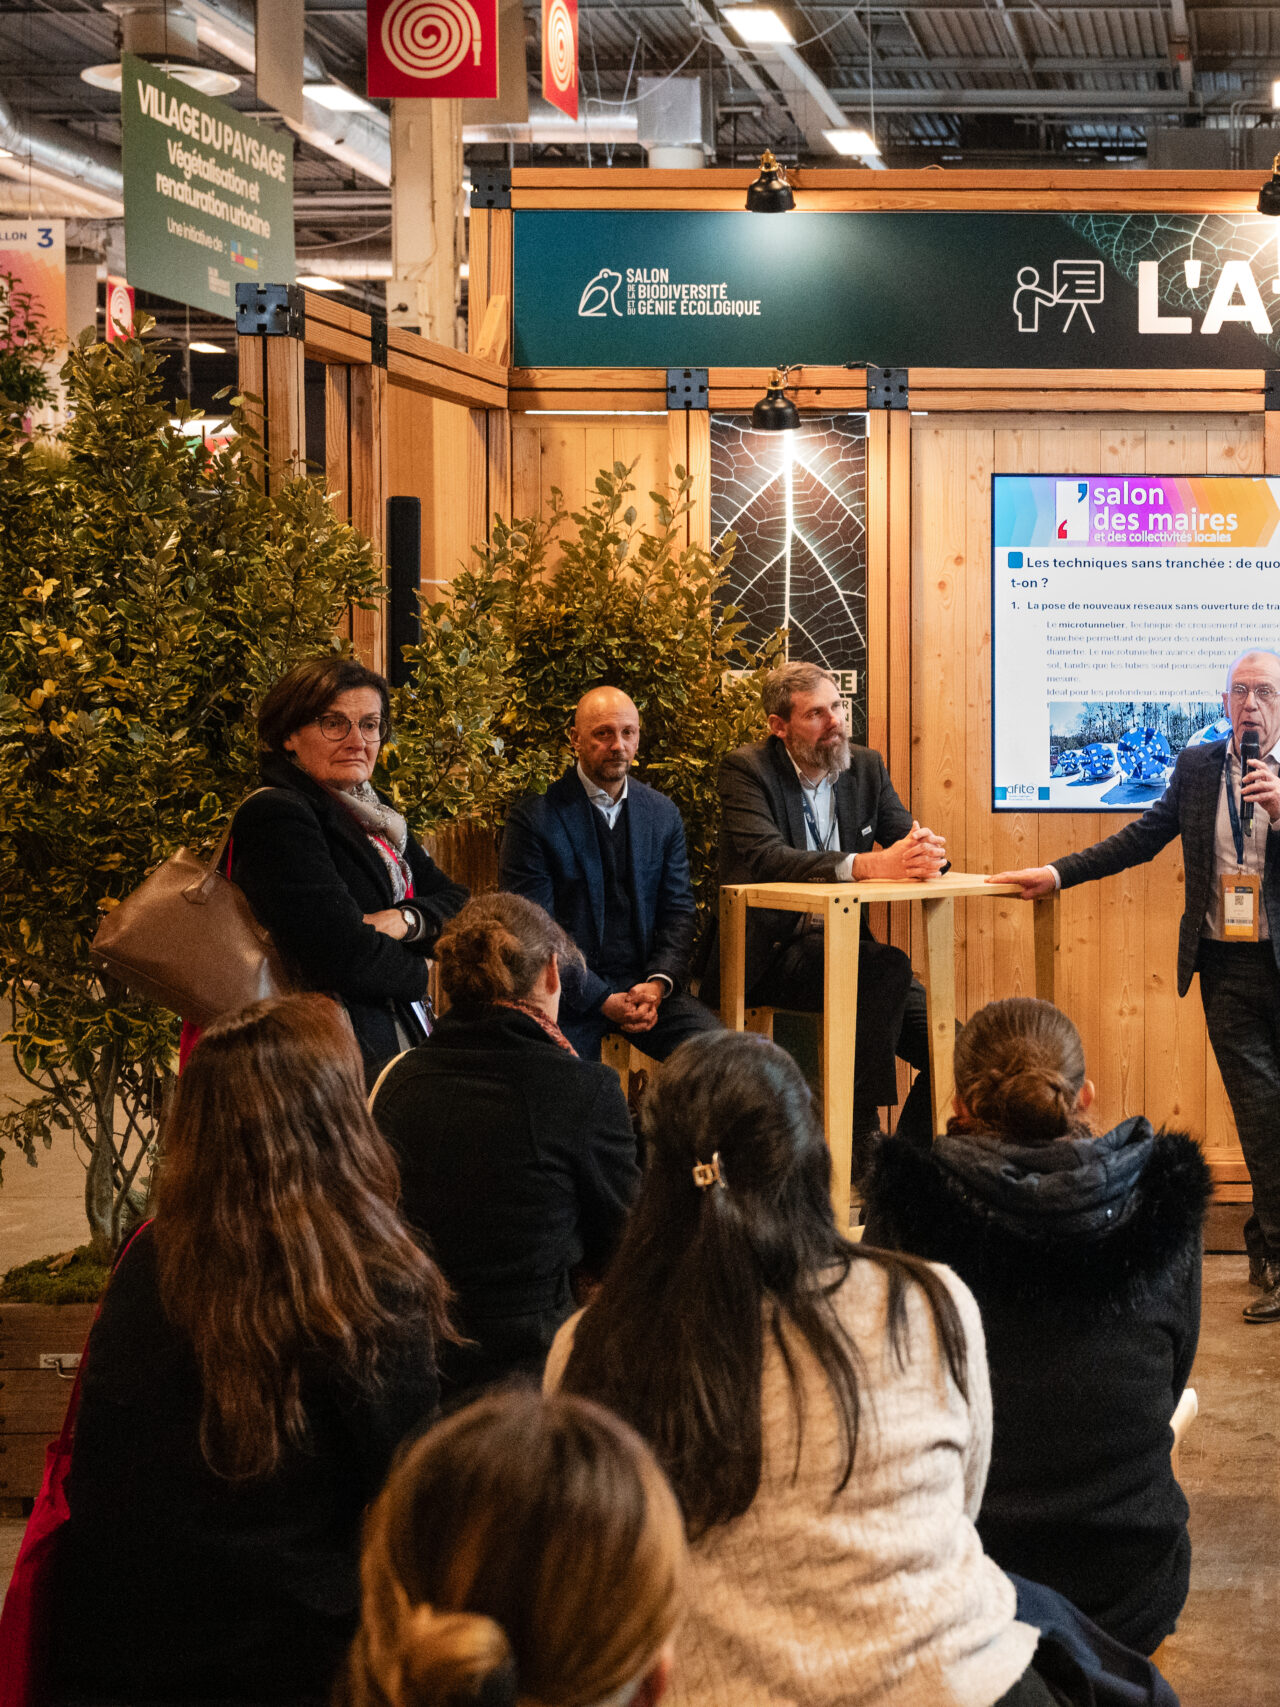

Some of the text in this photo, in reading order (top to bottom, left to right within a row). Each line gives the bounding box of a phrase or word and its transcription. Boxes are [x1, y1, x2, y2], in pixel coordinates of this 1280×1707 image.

[137, 79, 286, 183] VILLAGE DU PAYSAGE
[167, 139, 260, 204] Végétalisation et
[156, 172, 271, 239] renaturation urbaine
[37, 228, 54, 248] 3
[167, 217, 183, 238] Une
[183, 221, 213, 250] initiative
[213, 236, 223, 252] de
[626, 268, 669, 284] SALON
[638, 282, 727, 299] BIODIVERSITÉ
[638, 298, 761, 317] GÉNIE ÉCOLOGIQUE
[1093, 481, 1164, 505] salon
[1093, 507, 1238, 531] des maires
[1094, 530, 1231, 543] et des collectivités locales
[1027, 558, 1050, 569] Les
[1053, 557, 1128, 572] techniques
[1131, 560, 1162, 569] sans
[1165, 557, 1225, 569] tranchée
[1236, 557, 1252, 569] de
[1011, 577, 1049, 588] t-on ?
[1011, 602, 1020, 610] 1.
[1027, 602, 1039, 610] La
[1041, 602, 1066, 613] pose
[1068, 602, 1081, 610] de
[1083, 602, 1131, 610] nouveaux
[1201, 603, 1249, 611] ouverture
[1251, 602, 1264, 611] de
[1007, 784, 1034, 794] afite
